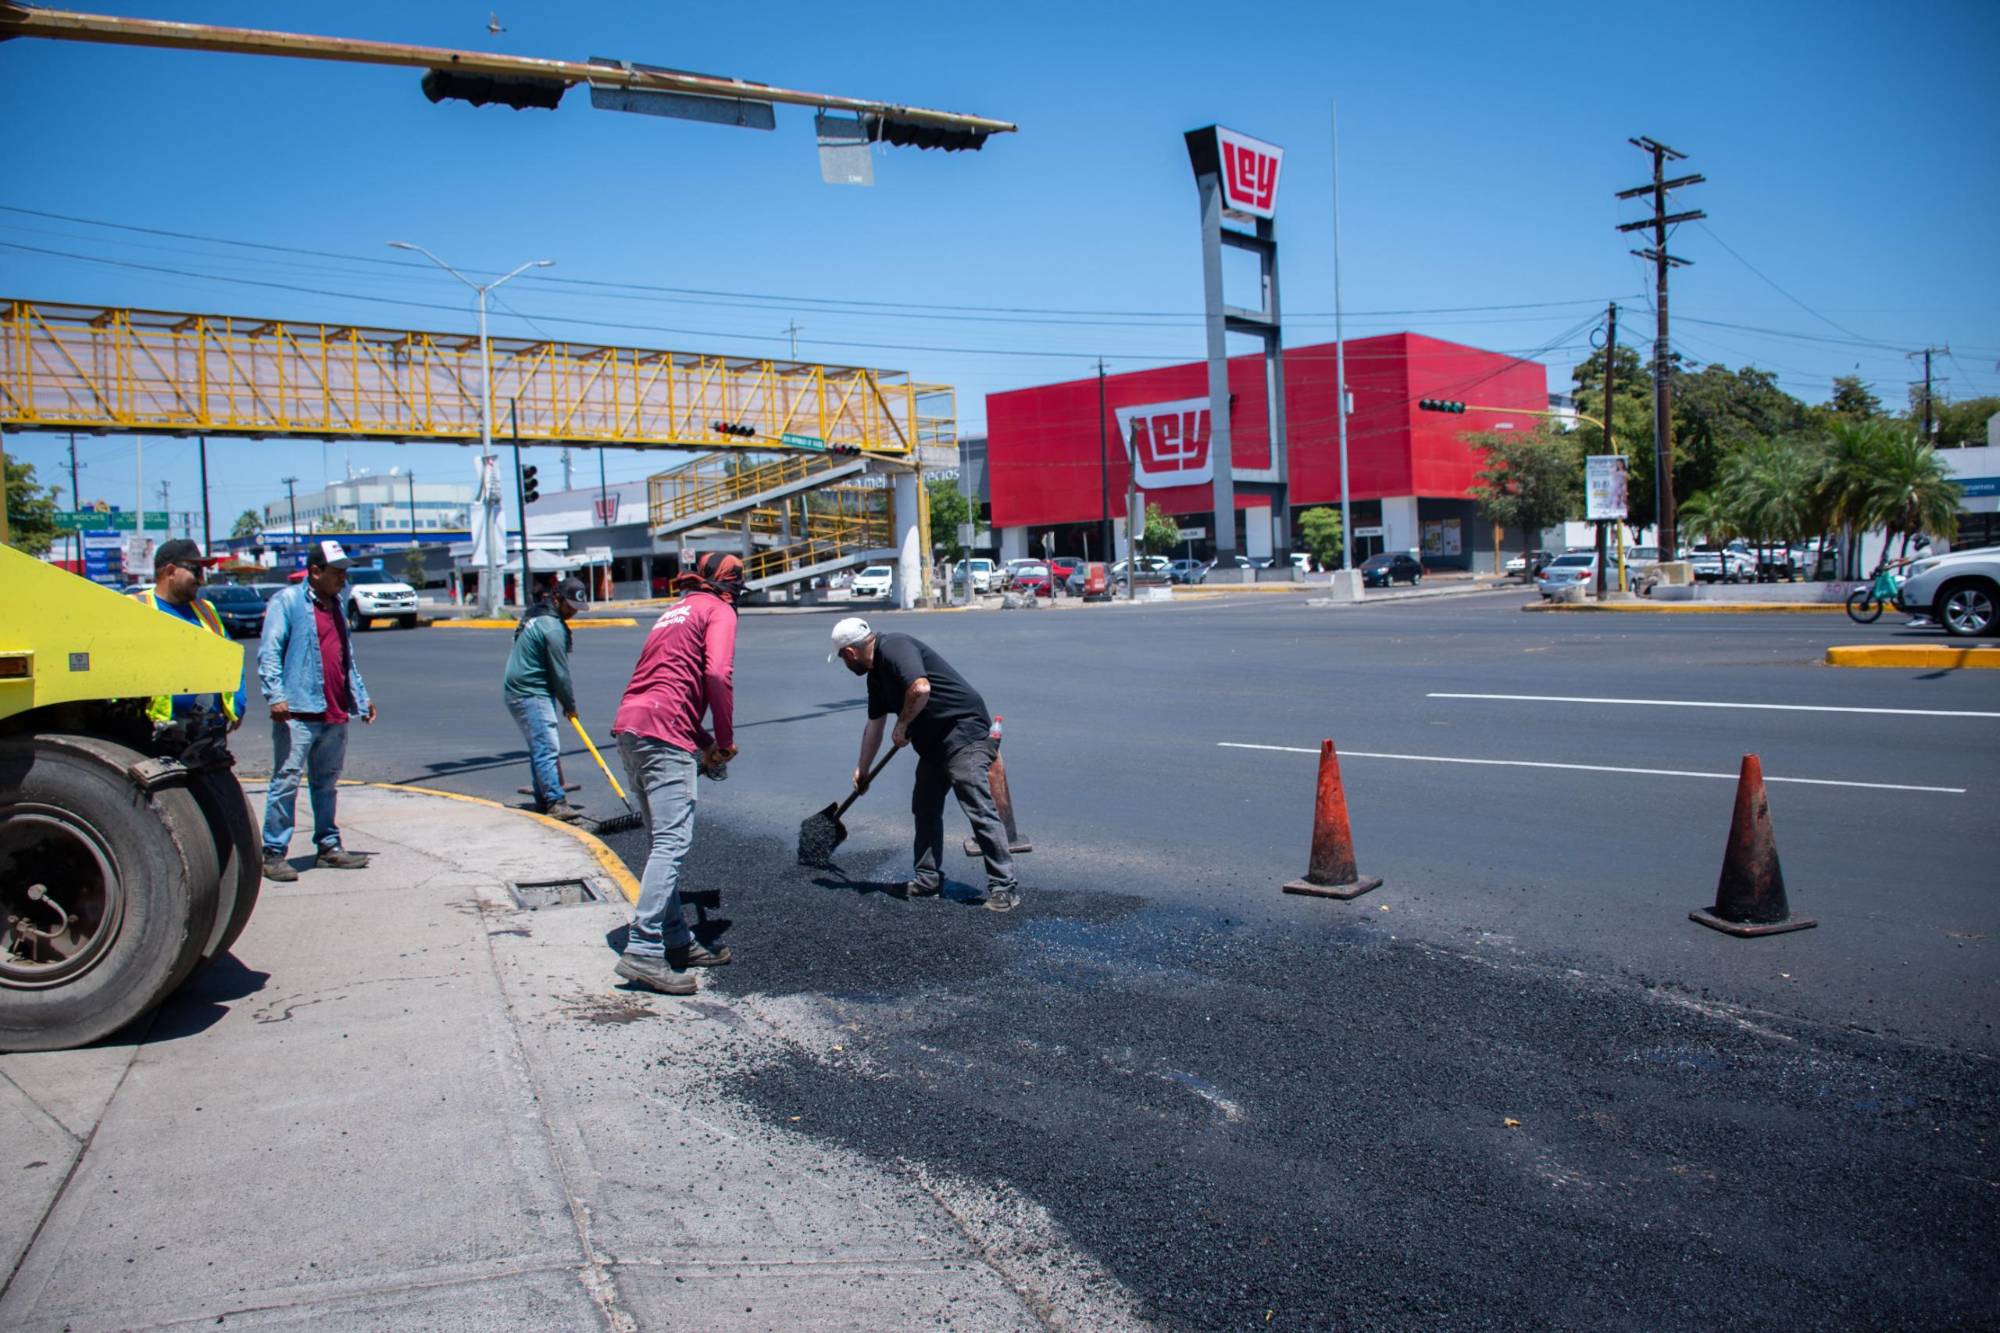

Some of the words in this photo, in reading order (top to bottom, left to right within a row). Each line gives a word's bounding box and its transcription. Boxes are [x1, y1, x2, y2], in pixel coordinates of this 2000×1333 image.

[1222, 141, 1278, 210] Ley
[1135, 409, 1212, 474] Ley
[924, 469, 960, 482] recios
